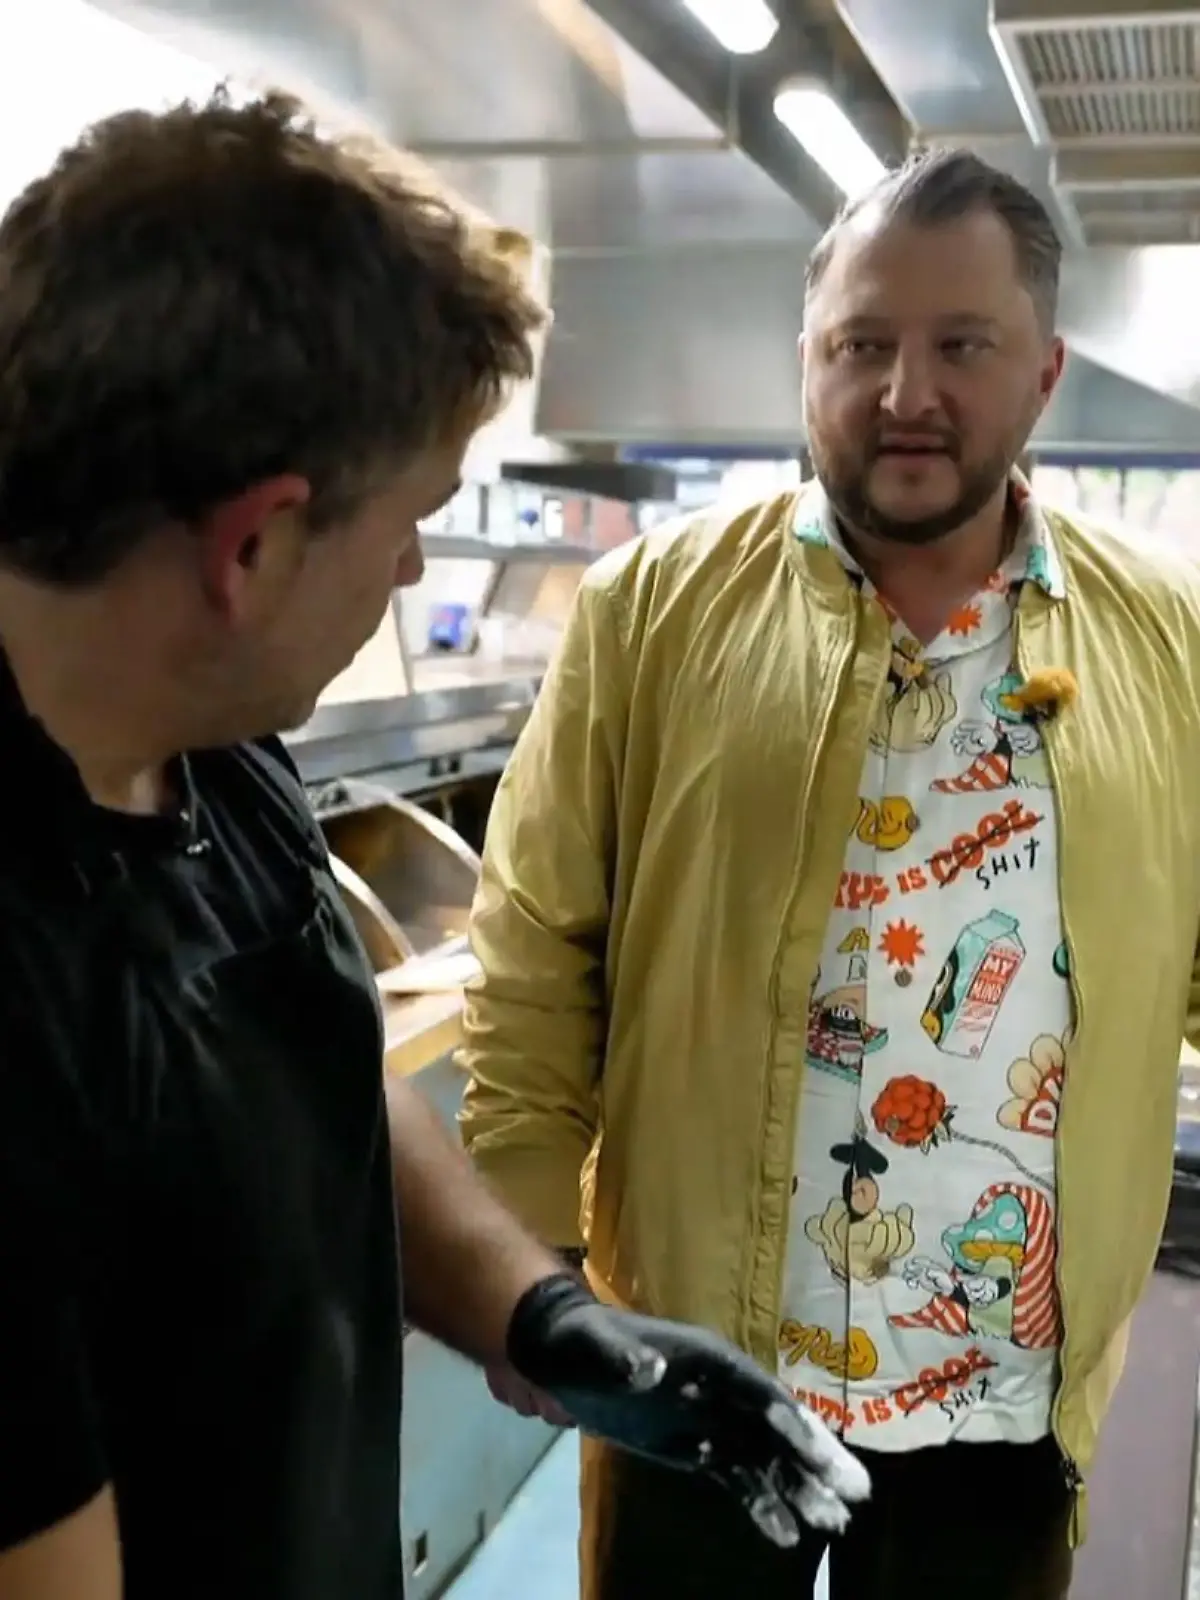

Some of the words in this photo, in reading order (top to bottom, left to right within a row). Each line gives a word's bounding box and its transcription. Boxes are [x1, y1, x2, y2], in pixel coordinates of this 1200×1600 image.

[896, 867, 927, 894] IS
[976, 836, 1040, 889] SHIT
[862, 1398, 892, 1425] IS
[939, 1375, 991, 1422] SHIT
